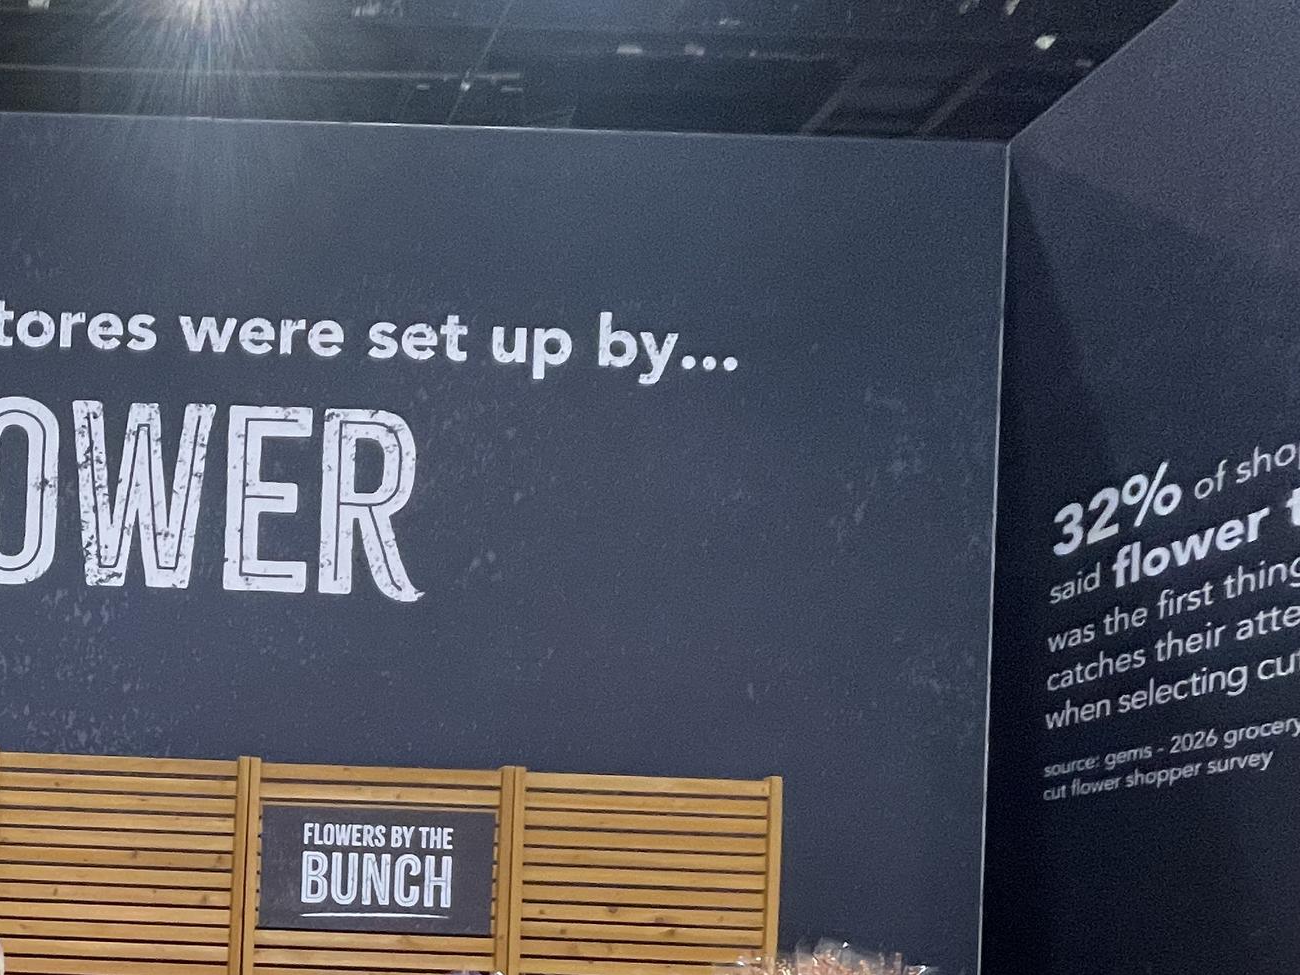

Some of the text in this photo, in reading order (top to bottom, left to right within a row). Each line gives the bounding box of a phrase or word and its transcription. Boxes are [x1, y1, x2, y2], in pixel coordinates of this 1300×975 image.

[178, 315, 345, 356] were
[368, 315, 468, 361] set
[492, 324, 572, 379] up
[599, 311, 738, 384] by...
[1053, 444, 1300, 556] 32% of sho
[1050, 561, 1101, 604] said
[1112, 506, 1270, 588] flower
[1047, 623, 1095, 653] was
[1104, 605, 1147, 637] the
[1158, 581, 1214, 621] first
[1046, 649, 1146, 692] catches
[1155, 622, 1226, 662] their
[1045, 697, 1111, 730] when
[1118, 666, 1248, 713] selecting
[1042, 750, 1274, 801] cut flower shopper survey
[1043, 756, 1100, 777] source:
[1104, 746, 1152, 769] gems
[1170, 728, 1218, 754] 2026
[1223, 716, 1300, 749] grocery
[303, 823, 454, 850] FLOWERS BY THE
[300, 850, 453, 908] BUNCH
